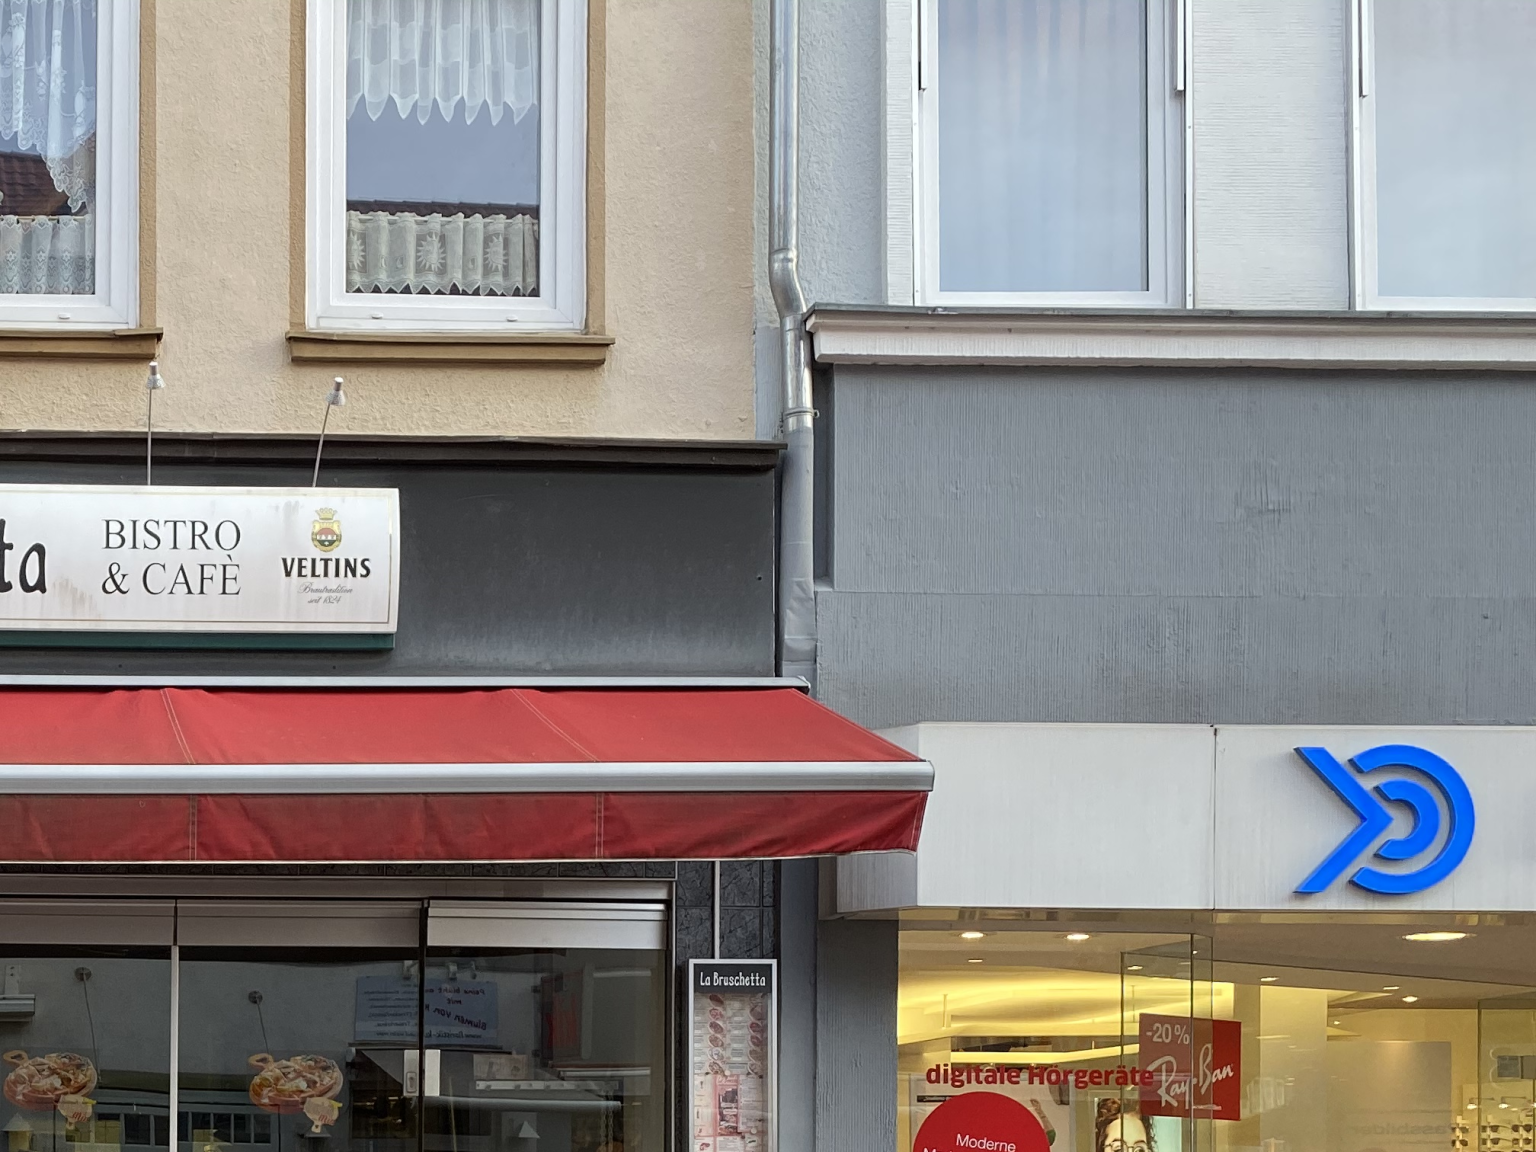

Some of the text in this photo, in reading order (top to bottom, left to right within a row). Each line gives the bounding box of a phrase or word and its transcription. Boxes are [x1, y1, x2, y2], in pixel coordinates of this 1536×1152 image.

[102, 519, 241, 551] BISTRO
[101, 554, 241, 596] & CAFÈ
[281, 557, 371, 578] VELTINS
[700, 971, 766, 987] La Bruschetta
[926, 1064, 1154, 1090] digitale Hörgeräte
[1146, 1043, 1234, 1110] Ray-Ban
